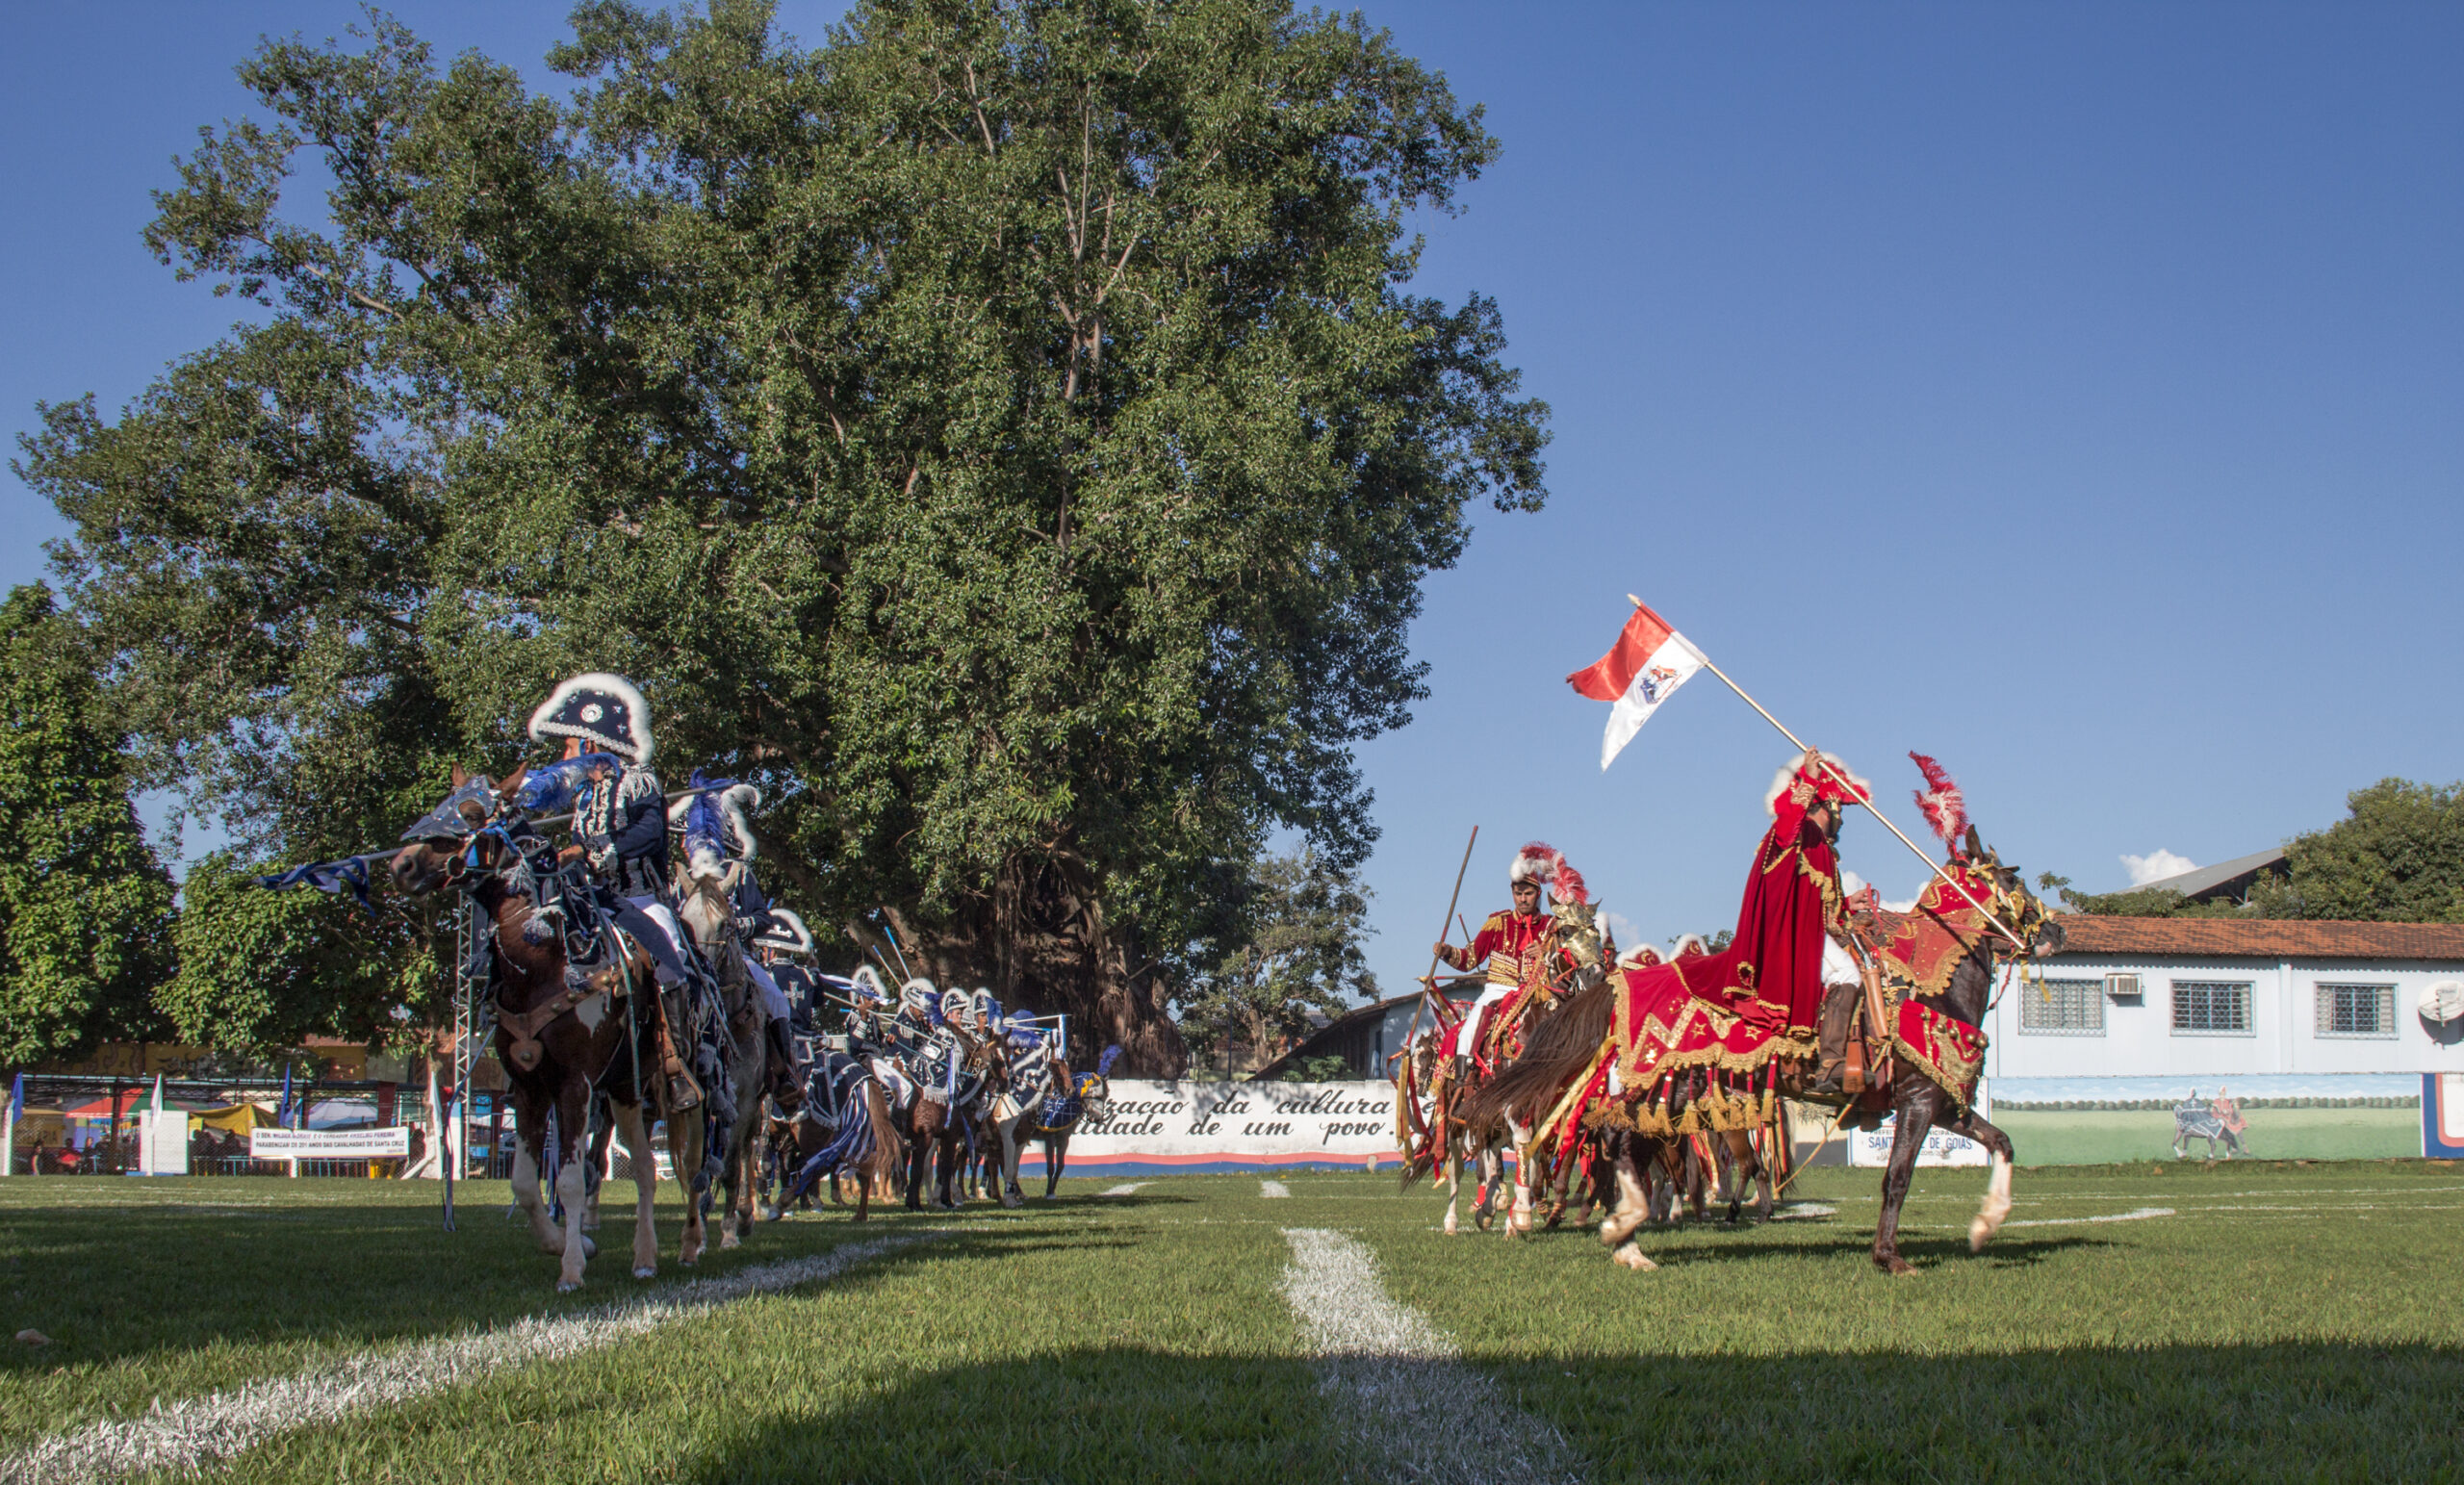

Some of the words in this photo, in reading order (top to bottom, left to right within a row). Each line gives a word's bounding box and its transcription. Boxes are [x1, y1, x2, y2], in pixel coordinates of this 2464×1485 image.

[1209, 1090, 1252, 1114] da
[1271, 1089, 1393, 1114] cultura
[1186, 1114, 1223, 1136] de
[1241, 1122, 1295, 1136] um
[1868, 1136, 1894, 1148] SANT
[1929, 1137, 1940, 1149] DE
